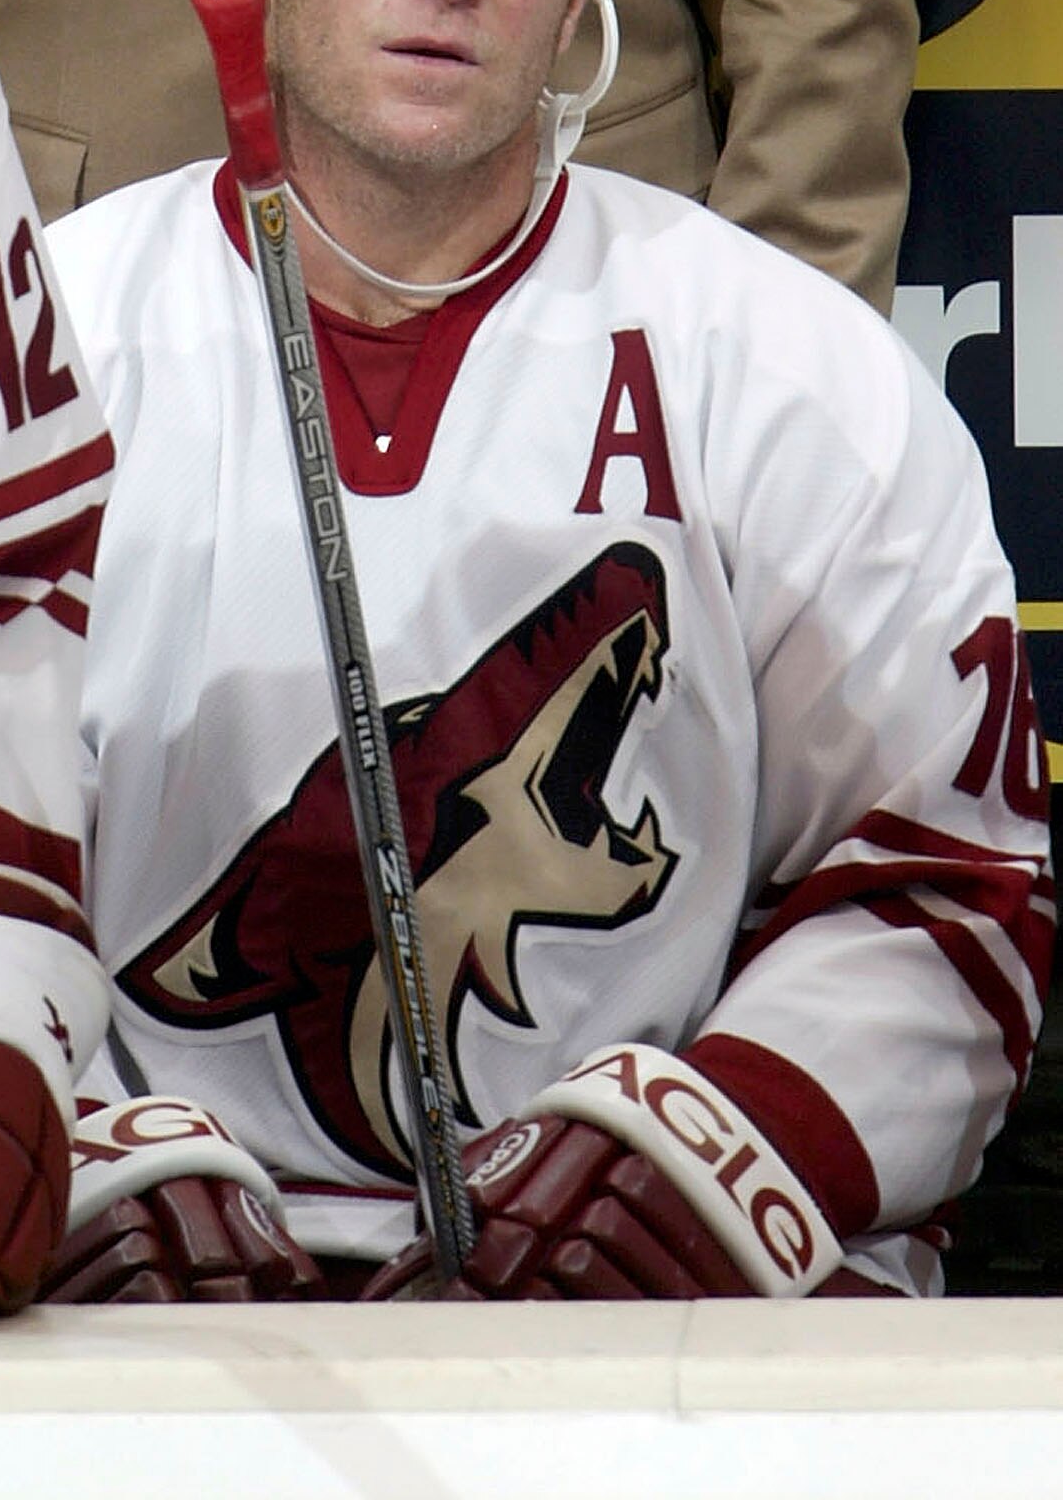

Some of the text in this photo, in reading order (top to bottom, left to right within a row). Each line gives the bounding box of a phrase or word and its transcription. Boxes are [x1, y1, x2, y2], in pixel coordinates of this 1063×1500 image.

[282, 331, 349, 582] EASTON
[574, 328, 683, 523] A
[355, 714, 378, 770] FLEX
